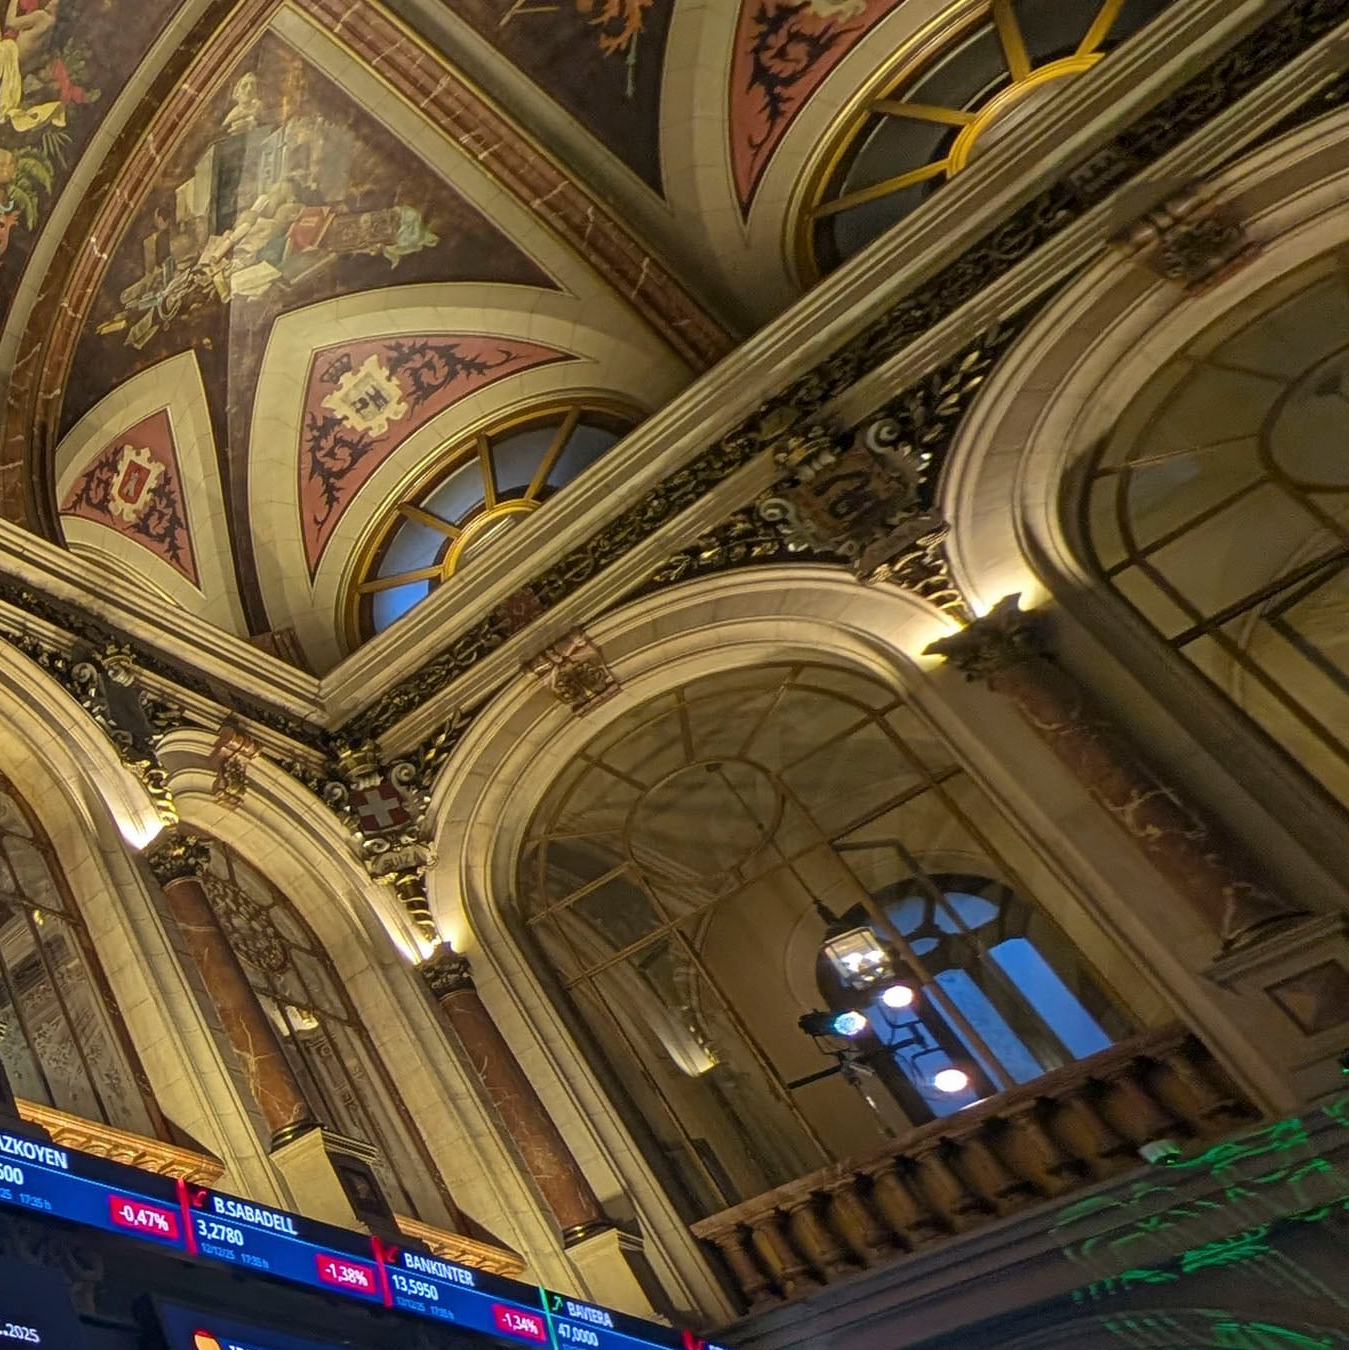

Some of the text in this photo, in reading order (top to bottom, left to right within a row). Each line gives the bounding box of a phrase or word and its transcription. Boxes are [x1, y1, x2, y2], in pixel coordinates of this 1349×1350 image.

[118, 1205, 169, 1232] -0,47%
[214, 1197, 297, 1235] B.SABADELL
[197, 1219, 243, 1246] 3,2780
[325, 1263, 369, 1287] -1,38%
[404, 1253, 474, 1286] BANKINTER
[392, 1275, 438, 1300] 13,5950
[501, 1312, 539, 1336] -1,34%
[567, 1302, 613, 1327] BAVIERA
